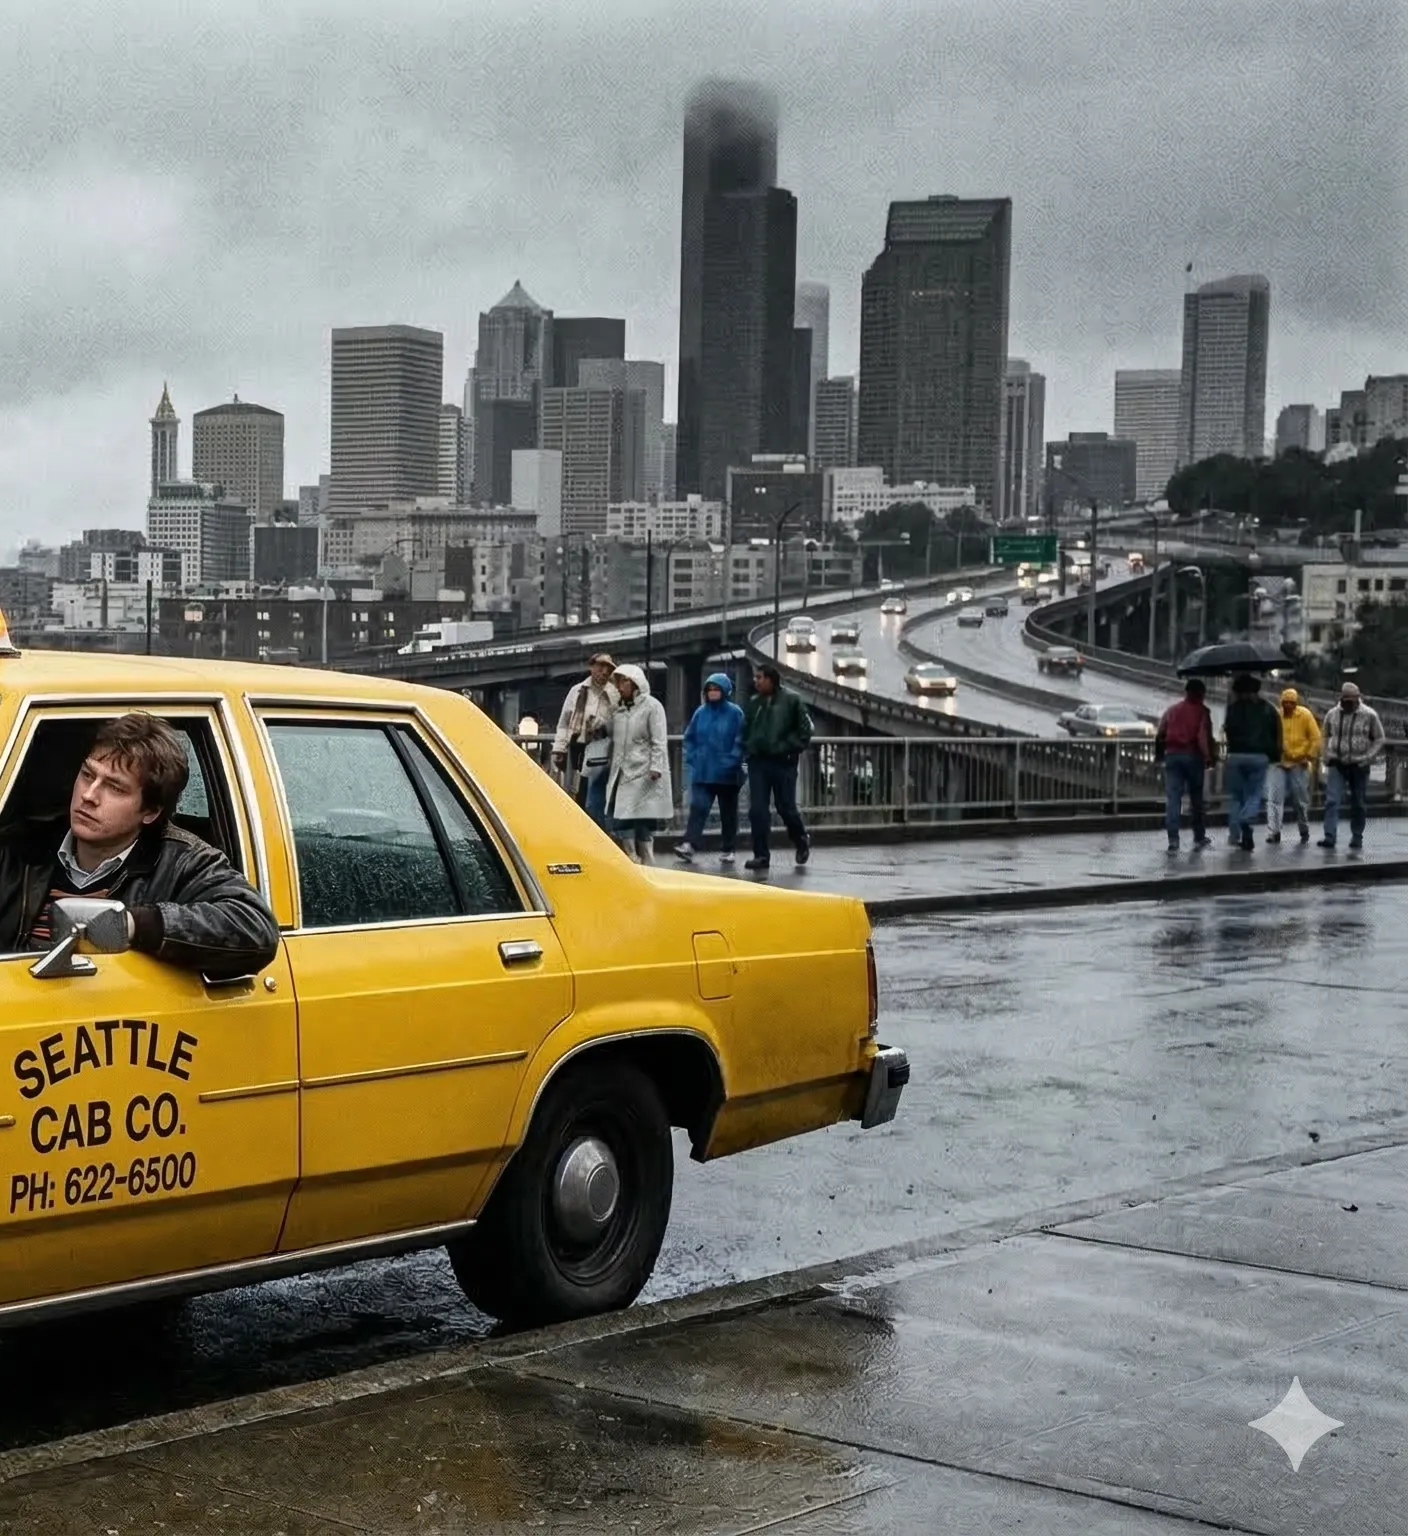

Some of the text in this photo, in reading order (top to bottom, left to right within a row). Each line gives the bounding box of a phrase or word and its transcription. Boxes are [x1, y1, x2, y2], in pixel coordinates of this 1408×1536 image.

[13, 1019, 198, 1099] SEATTLE
[31, 1092, 186, 1154] CAB CO.
[9, 1152, 196, 1214] PH: 622-6500
